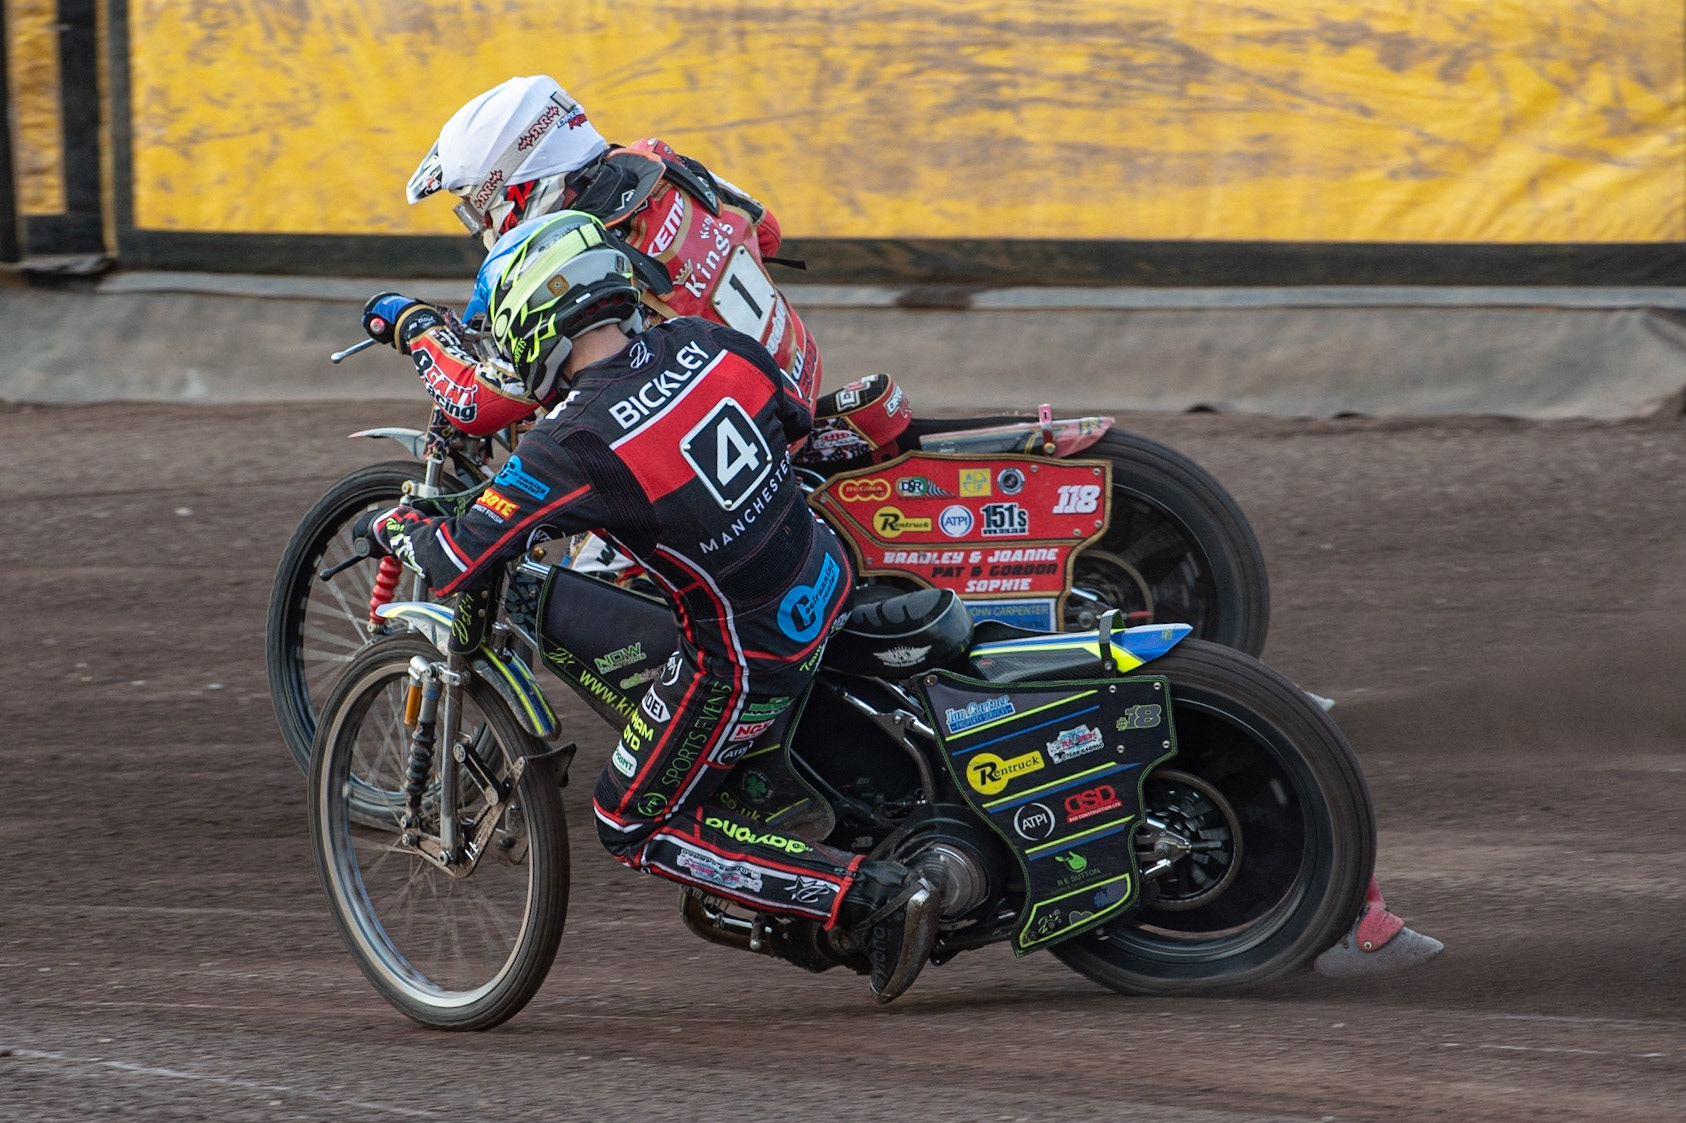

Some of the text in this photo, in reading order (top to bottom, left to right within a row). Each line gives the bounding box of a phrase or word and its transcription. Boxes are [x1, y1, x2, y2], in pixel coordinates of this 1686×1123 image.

[729, 273, 763, 320] 1
[608, 340, 709, 430] BICKLEY
[716, 416, 759, 487] 4
[699, 450, 792, 554] MANCHESTER
[1052, 485, 1101, 514] 118
[878, 513, 929, 531] Rentruck
[945, 516, 967, 526] ATPI
[883, 548, 1059, 564] BRADLEY & JOANNE
[931, 566, 965, 578] PAT
[988, 563, 1058, 577] GORDON
[965, 578, 1032, 592] SOPHIE
[993, 605, 1049, 616] CARPENTER
[594, 642, 642, 668] NOW
[662, 731, 707, 788] SPORTS
[973, 755, 1041, 786] Rentruck
[1022, 813, 1048, 831] ATPI
